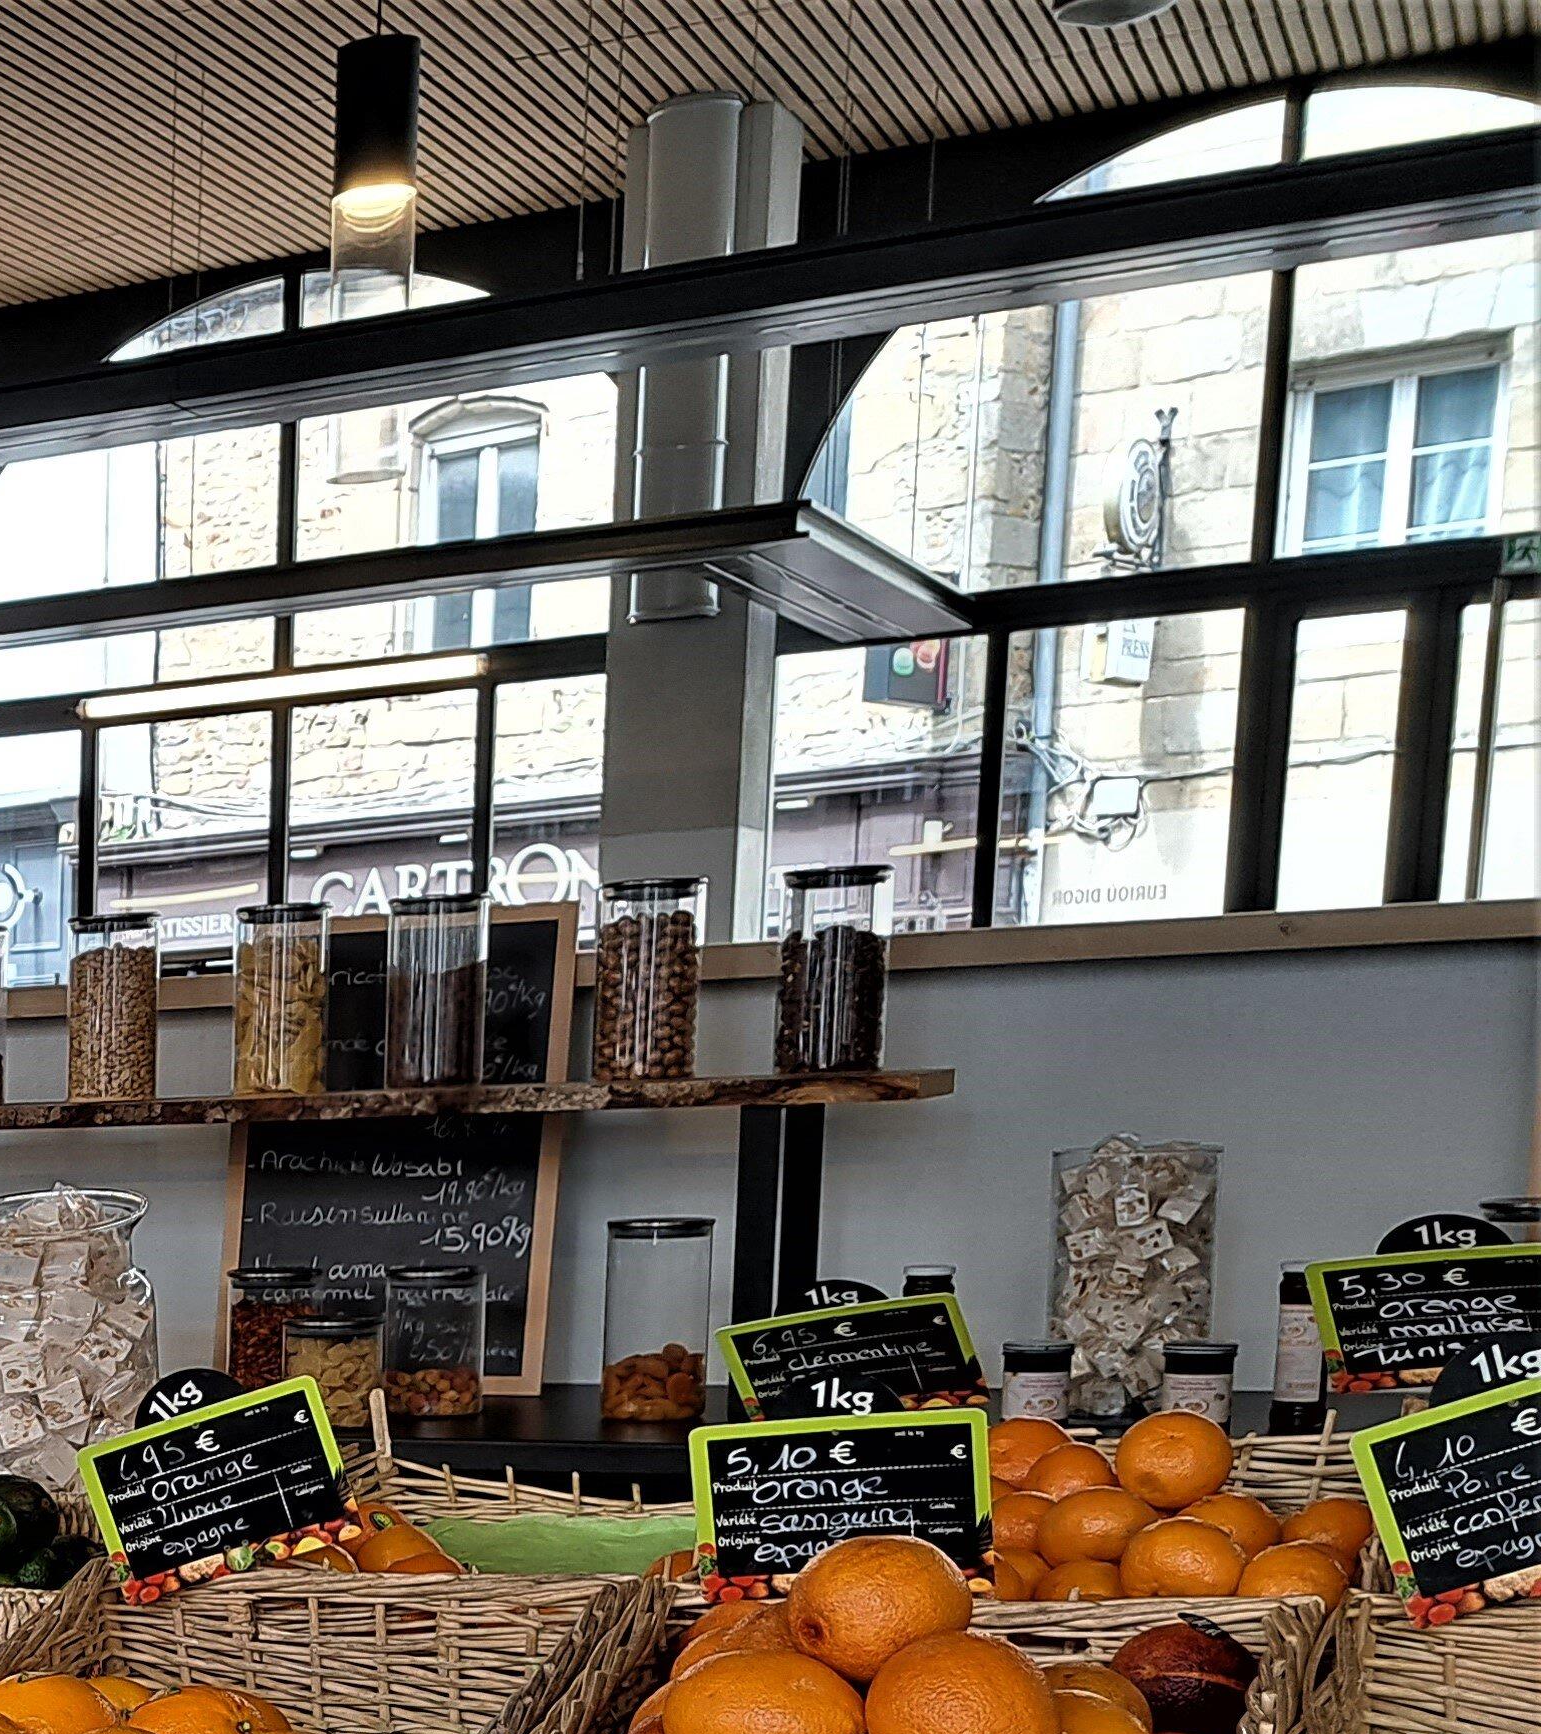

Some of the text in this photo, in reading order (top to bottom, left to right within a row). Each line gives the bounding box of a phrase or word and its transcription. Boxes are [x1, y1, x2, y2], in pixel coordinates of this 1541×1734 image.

[1413, 1220, 1477, 1250] 1kg
[1442, 1267, 1470, 1286] €
[804, 1285, 860, 1306] 1kg
[1379, 1294, 1524, 1318] orange
[833, 1321, 858, 1338] €
[148, 1379, 204, 1421] 1kg
[810, 1376, 875, 1416] 1kg
[195, 1429, 221, 1452] €
[828, 1440, 857, 1465] €
[107, 1484, 147, 1506] Produit
[151, 1452, 260, 1502] orange
[712, 1476, 889, 1505] Produit orange
[1388, 1476, 1442, 1503] Produit
[118, 1513, 155, 1535] Variété
[716, 1511, 758, 1527] Variété
[1402, 1512, 1451, 1541] Variété
[125, 1534, 163, 1553] Origine
[717, 1534, 762, 1549] Origine
[1410, 1540, 1462, 1564] Origine
